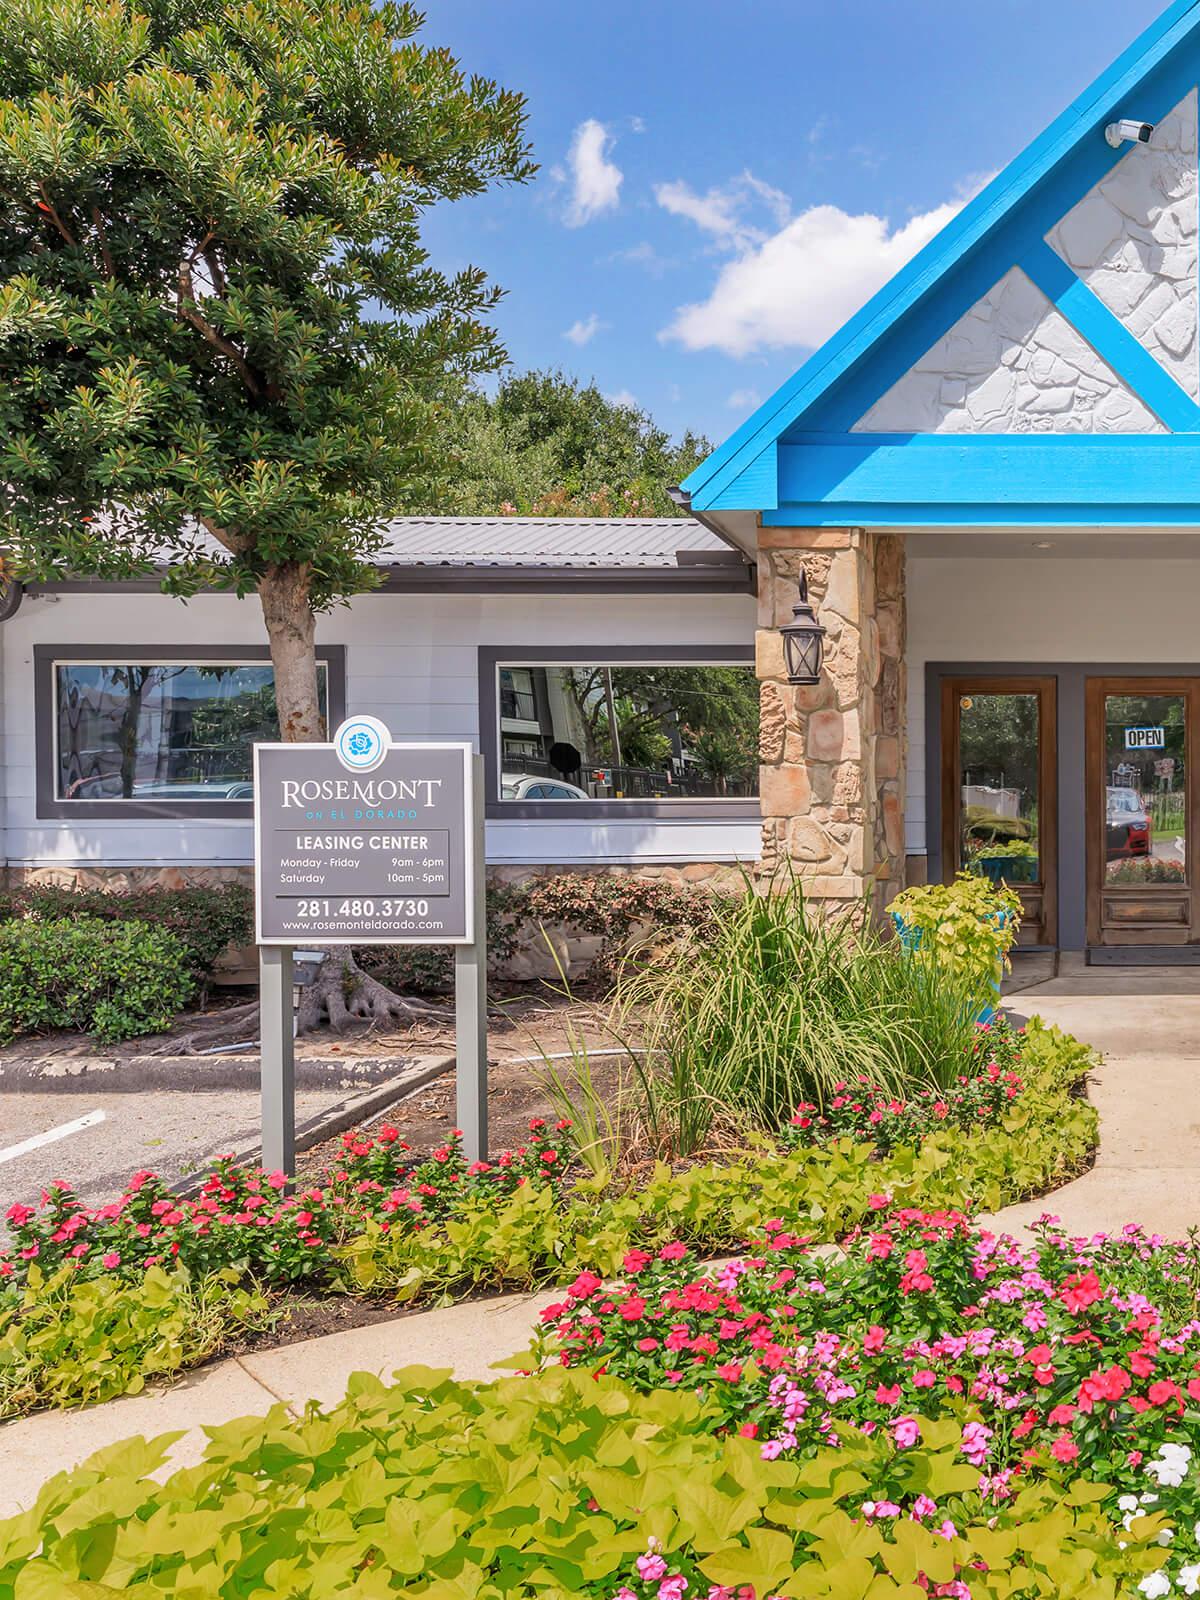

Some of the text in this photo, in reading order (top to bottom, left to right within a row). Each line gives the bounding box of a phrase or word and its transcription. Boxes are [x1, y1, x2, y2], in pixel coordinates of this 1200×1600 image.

[1128, 730, 1162, 746] OPEN
[281, 780, 442, 808] ROSEMONT
[331, 810, 346, 820] EL
[354, 809, 417, 819] DORADO
[296, 836, 428, 850] LEASING CENTER
[280, 859, 322, 869] Monday
[330, 858, 360, 869] Friday
[392, 858, 414, 867] 9am
[423, 858, 444, 868] 6pm
[280, 873, 325, 884] Saturday
[387, 873, 414, 883] 10am
[423, 873, 444, 884] 5pm
[297, 901, 429, 917] 281.480.3730
[283, 920, 443, 930] www.rosemonteldorado.com
